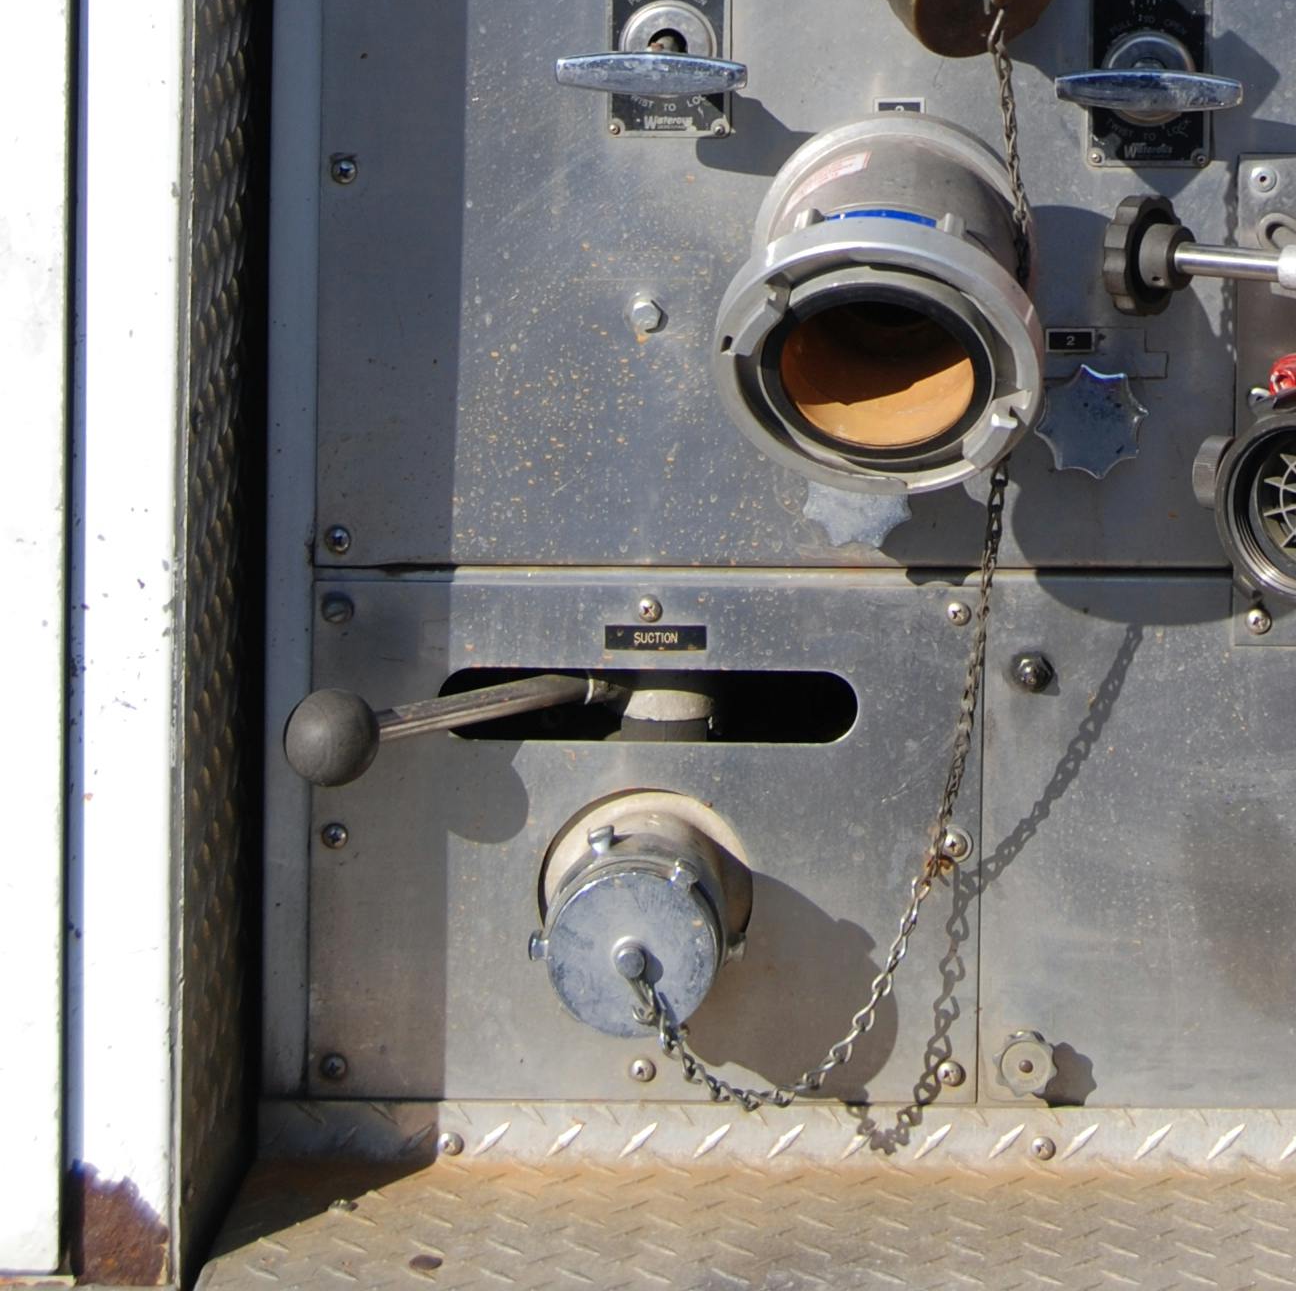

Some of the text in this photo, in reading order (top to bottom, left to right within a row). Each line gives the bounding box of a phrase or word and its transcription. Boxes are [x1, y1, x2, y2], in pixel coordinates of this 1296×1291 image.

[663, 103, 676, 112] TO
[1066, 336, 1076, 346] 2
[634, 632, 678, 644] SUCTION
